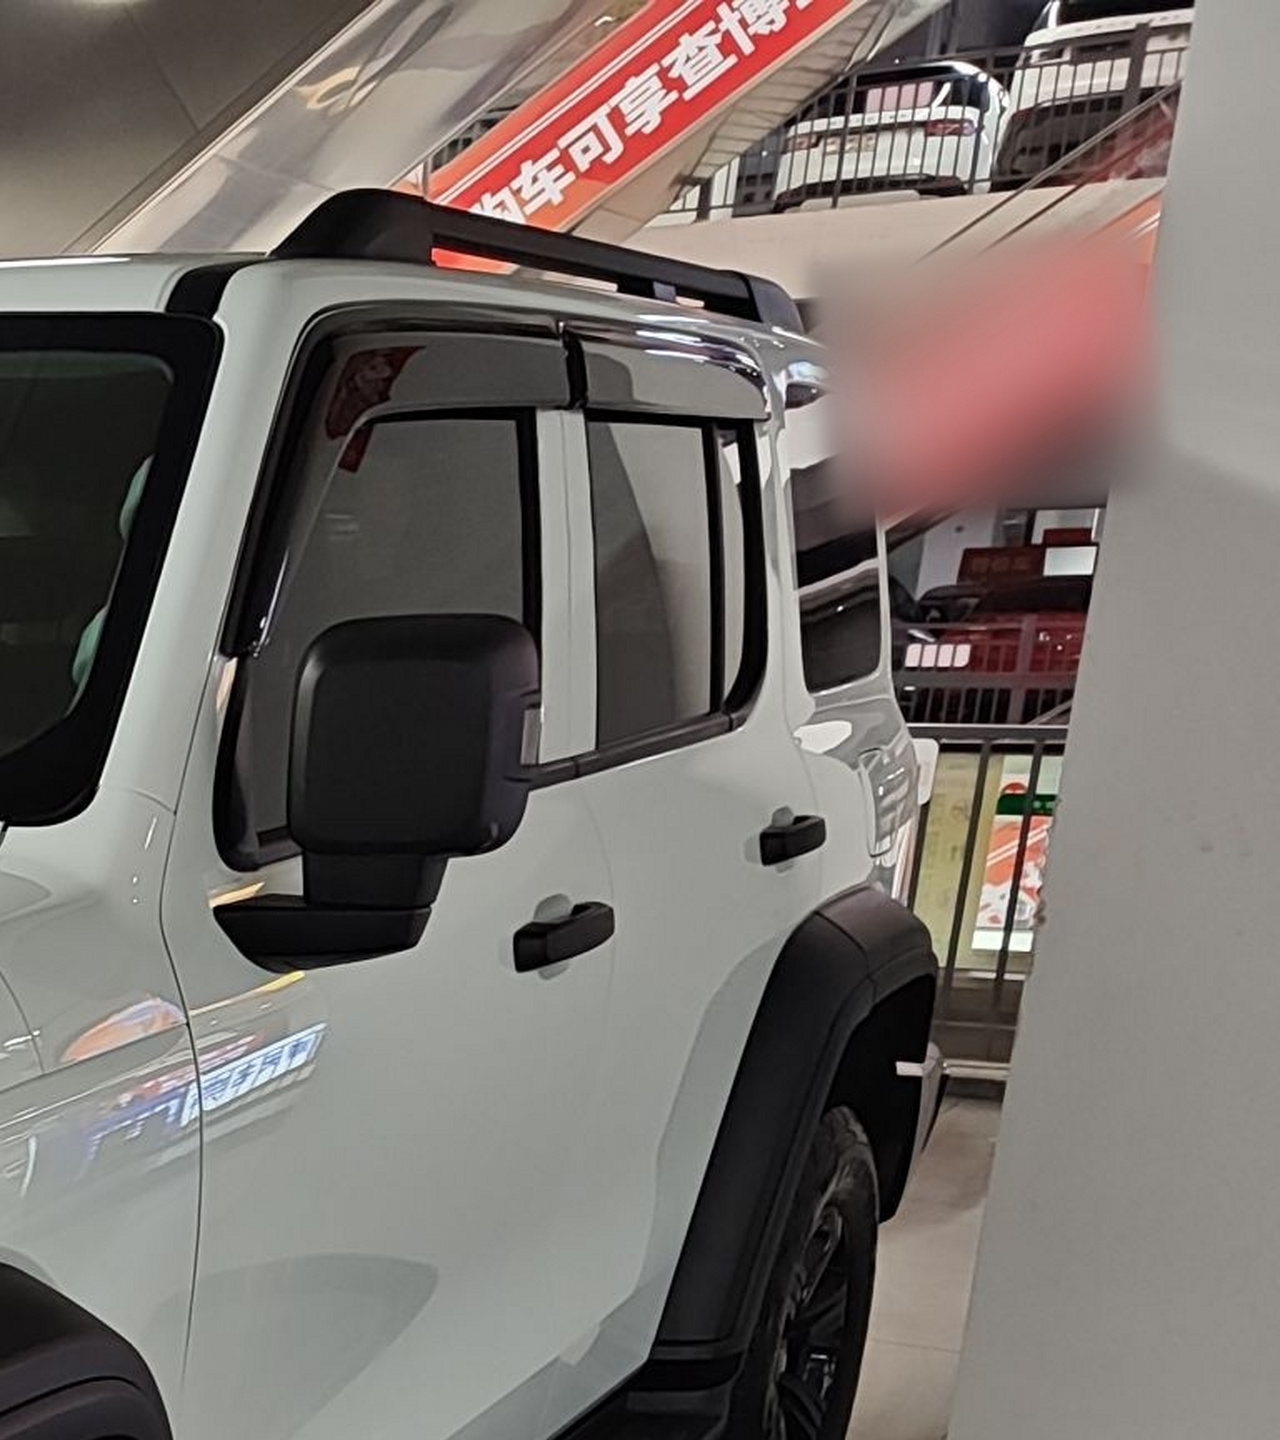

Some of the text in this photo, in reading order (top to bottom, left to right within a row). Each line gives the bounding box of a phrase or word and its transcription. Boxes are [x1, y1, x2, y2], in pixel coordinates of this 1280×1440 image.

[470, 0, 813, 223] 车可享查博
